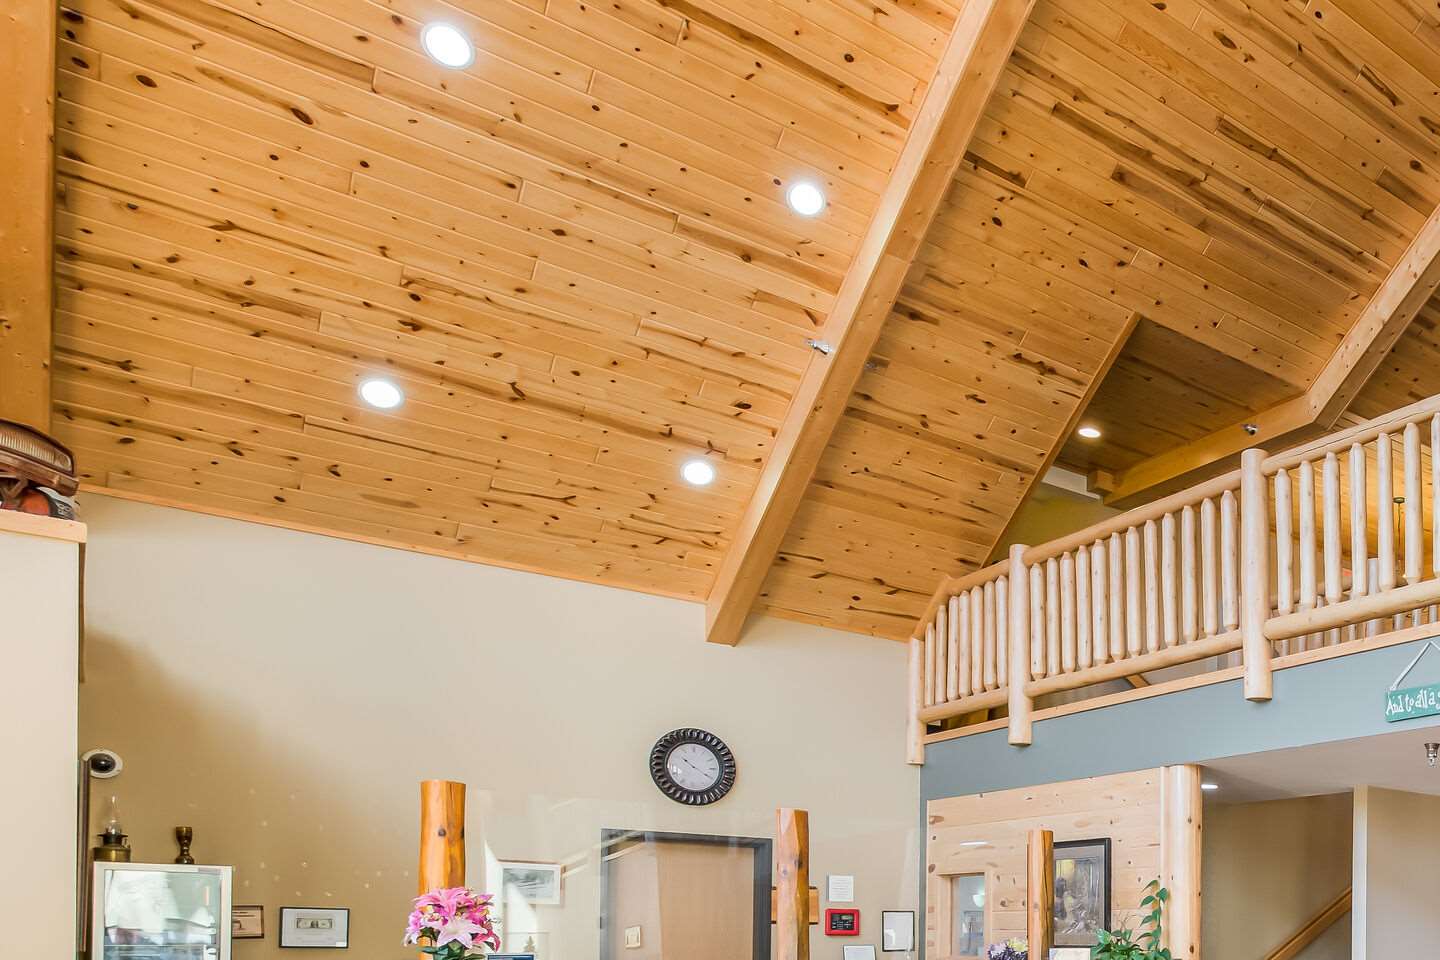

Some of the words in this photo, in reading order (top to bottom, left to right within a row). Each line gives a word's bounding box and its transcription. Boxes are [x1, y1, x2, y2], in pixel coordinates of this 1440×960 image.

[1386, 695, 1404, 715] And
[1405, 693, 1415, 712] to
[1415, 688, 1428, 709] all
[1429, 691, 1436, 705] a
